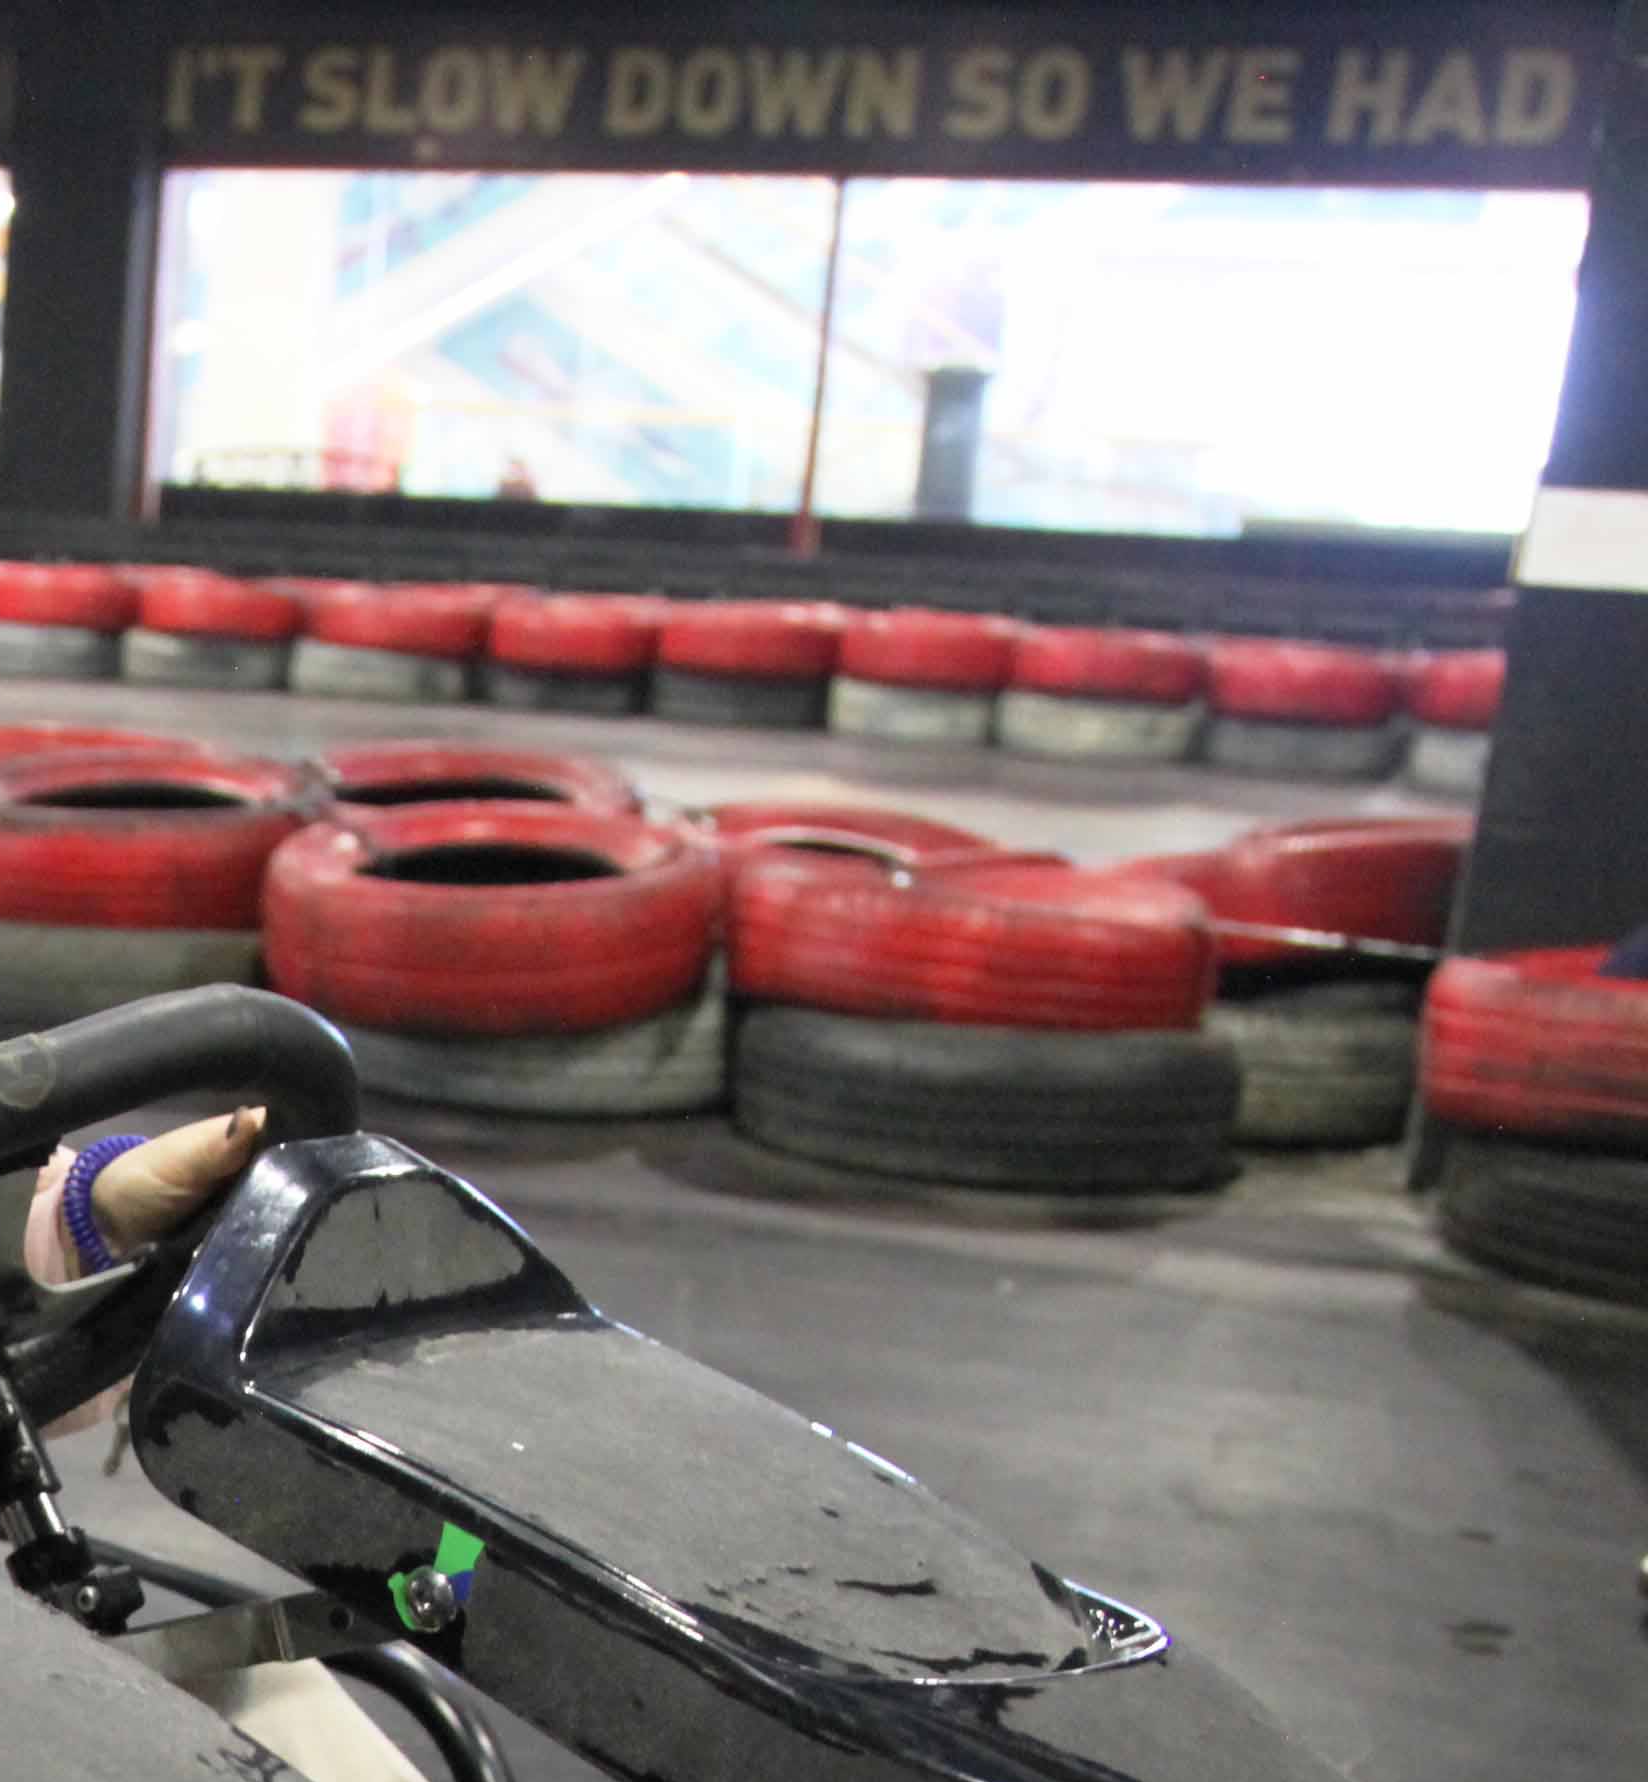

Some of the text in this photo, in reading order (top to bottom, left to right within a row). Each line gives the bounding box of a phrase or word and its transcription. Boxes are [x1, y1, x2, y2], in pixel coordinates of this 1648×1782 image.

[298, 48, 586, 135] SLOW
[605, 48, 921, 138] DOWN
[945, 47, 1091, 138] SO
[1121, 47, 1301, 143] WE
[1324, 49, 1574, 145] HAD
